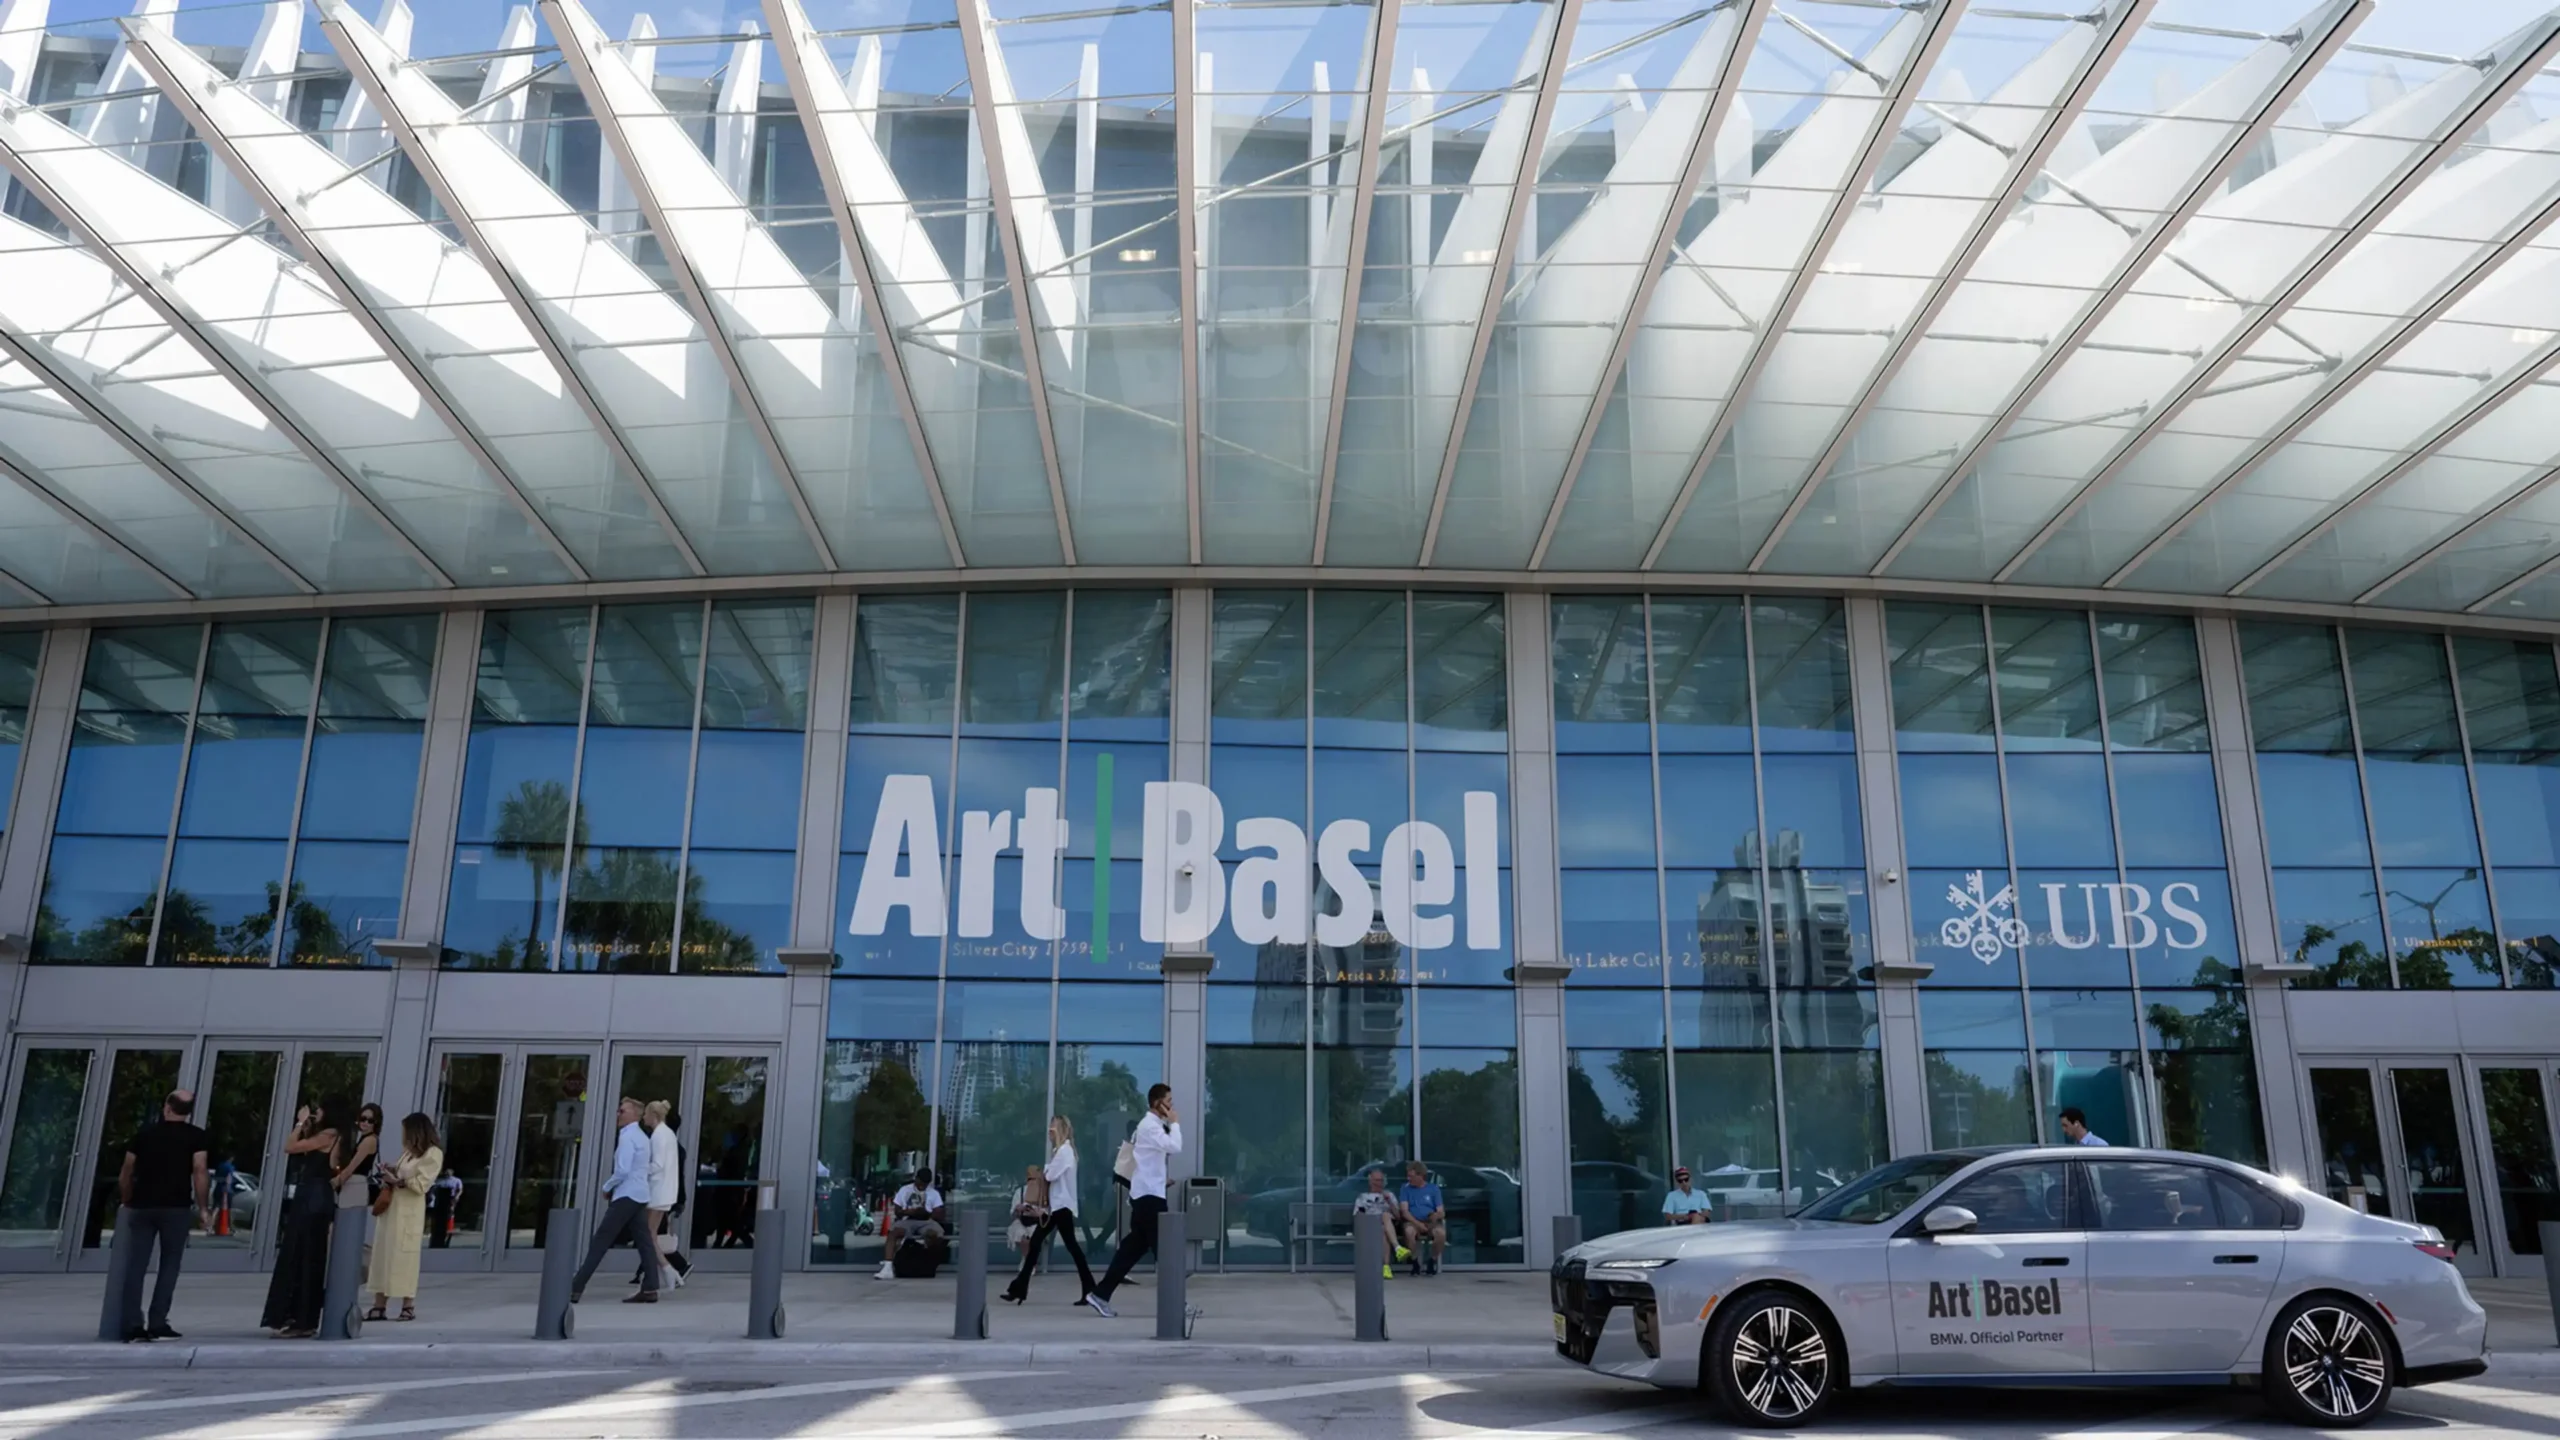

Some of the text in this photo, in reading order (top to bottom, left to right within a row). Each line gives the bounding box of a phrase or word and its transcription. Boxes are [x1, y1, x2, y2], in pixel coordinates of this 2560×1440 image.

[849, 774, 1502, 949] Art Basel
[2039, 882, 2208, 950] UBS
[551, 938, 640, 956] ontpelier
[1586, 952, 1629, 968] Lake
[1928, 1277, 2062, 1318] Art Basel
[1931, 1330, 2065, 1345] BMW. Official Partner
